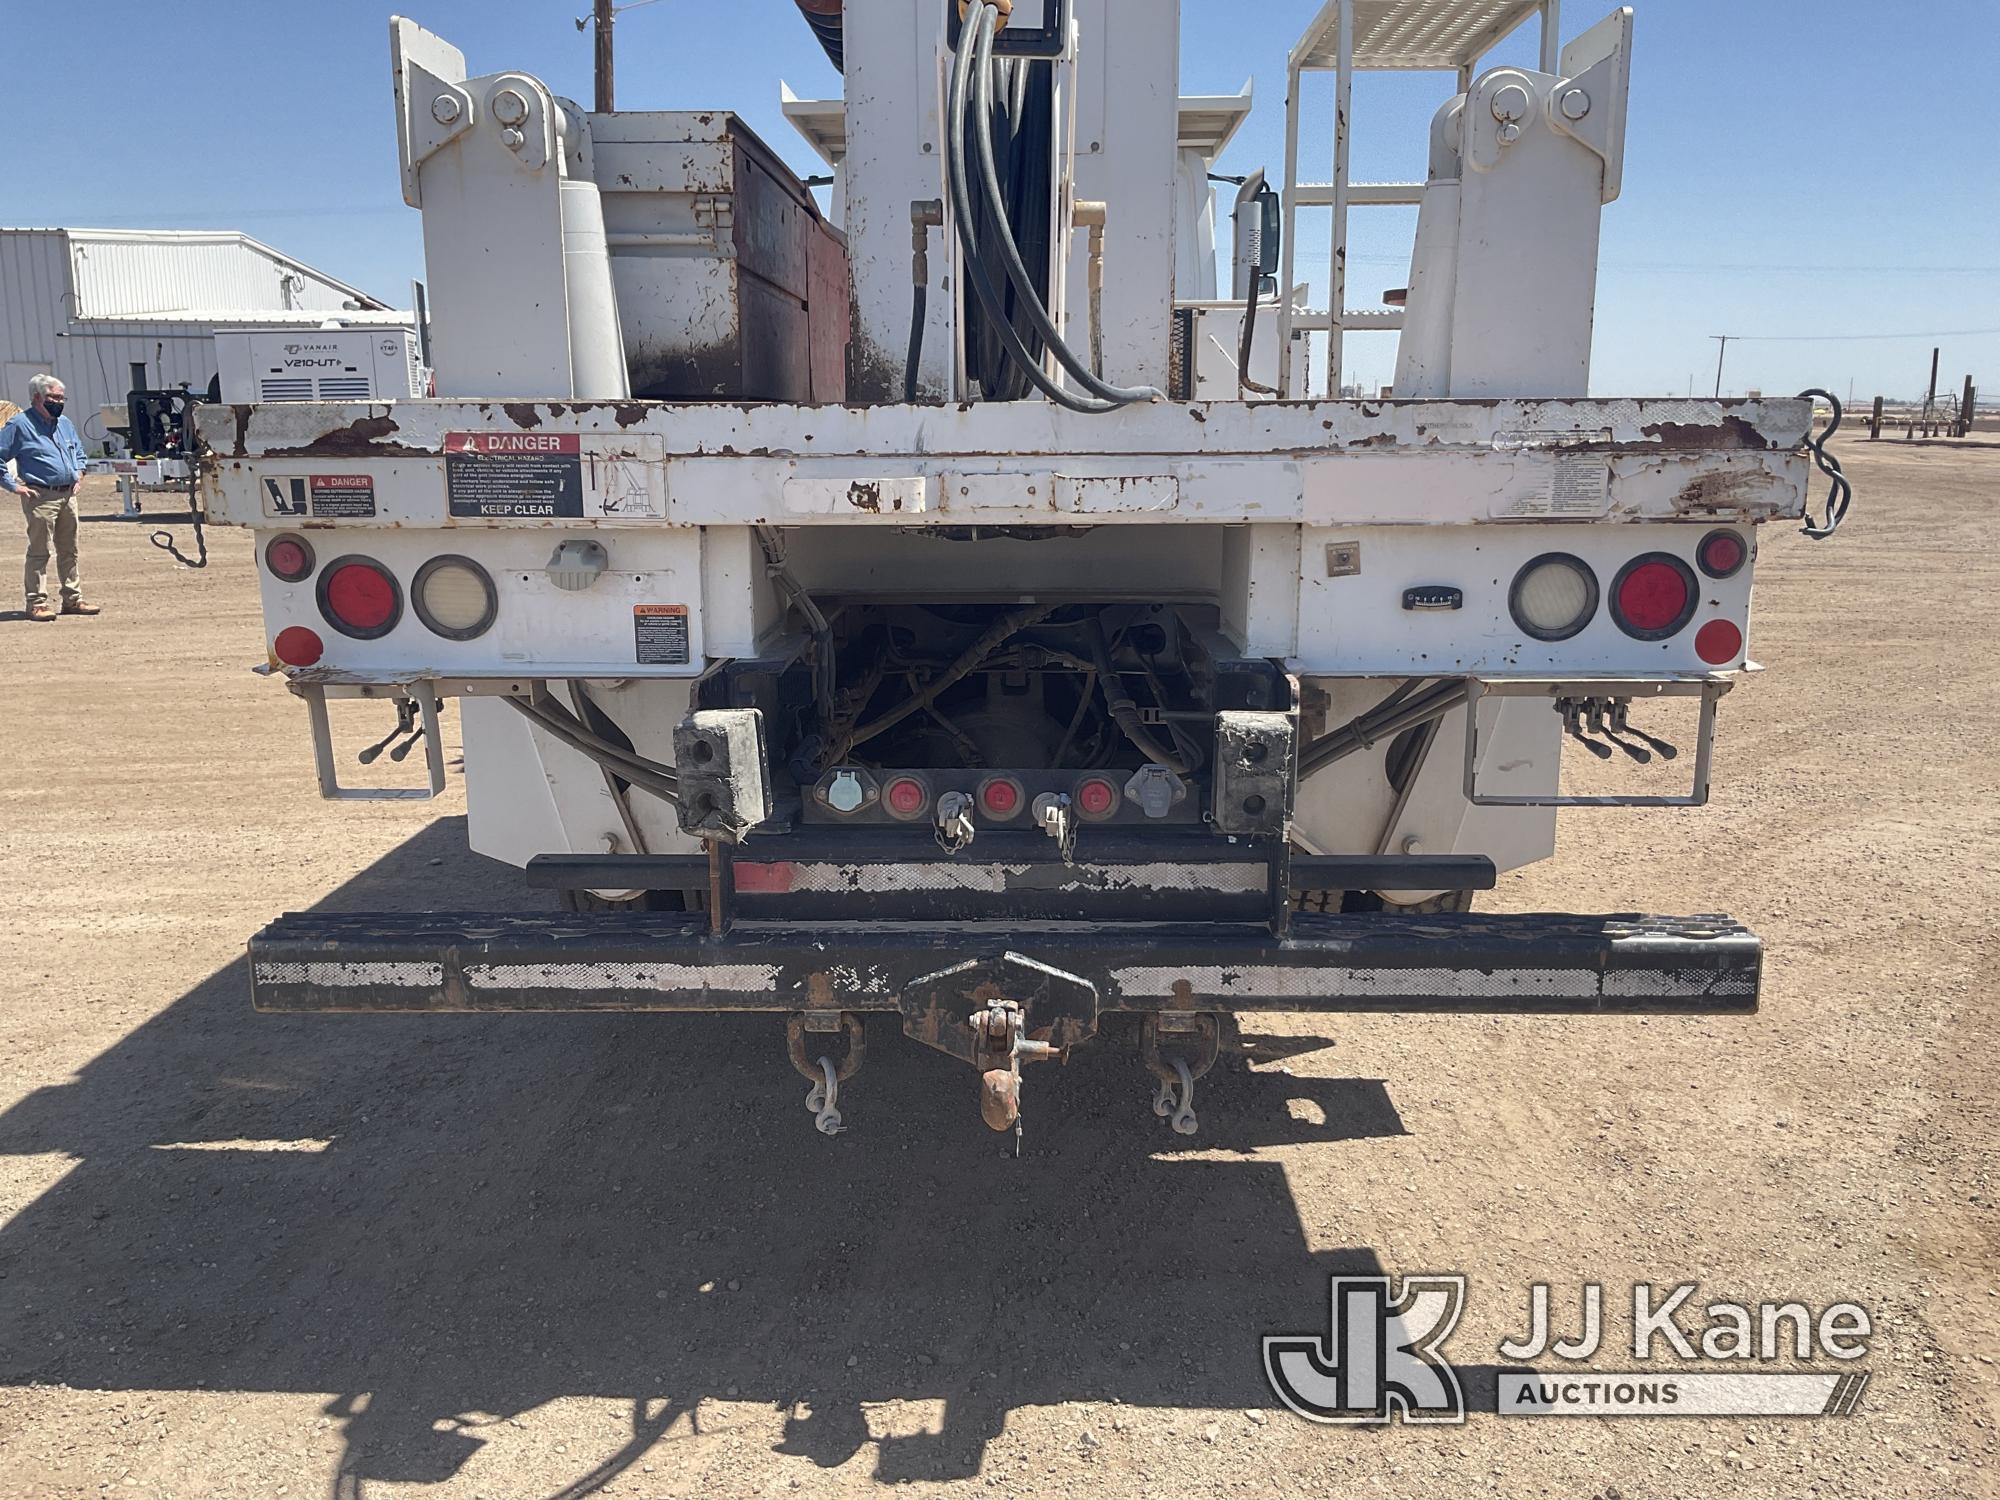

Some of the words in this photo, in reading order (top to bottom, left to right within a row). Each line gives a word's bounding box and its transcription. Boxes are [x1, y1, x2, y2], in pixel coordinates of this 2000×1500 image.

[488, 436, 560, 450] DANGER
[331, 478, 368, 486] DANGER
[481, 504, 512, 514] KEEP
[514, 505, 554, 515] CLEAR
